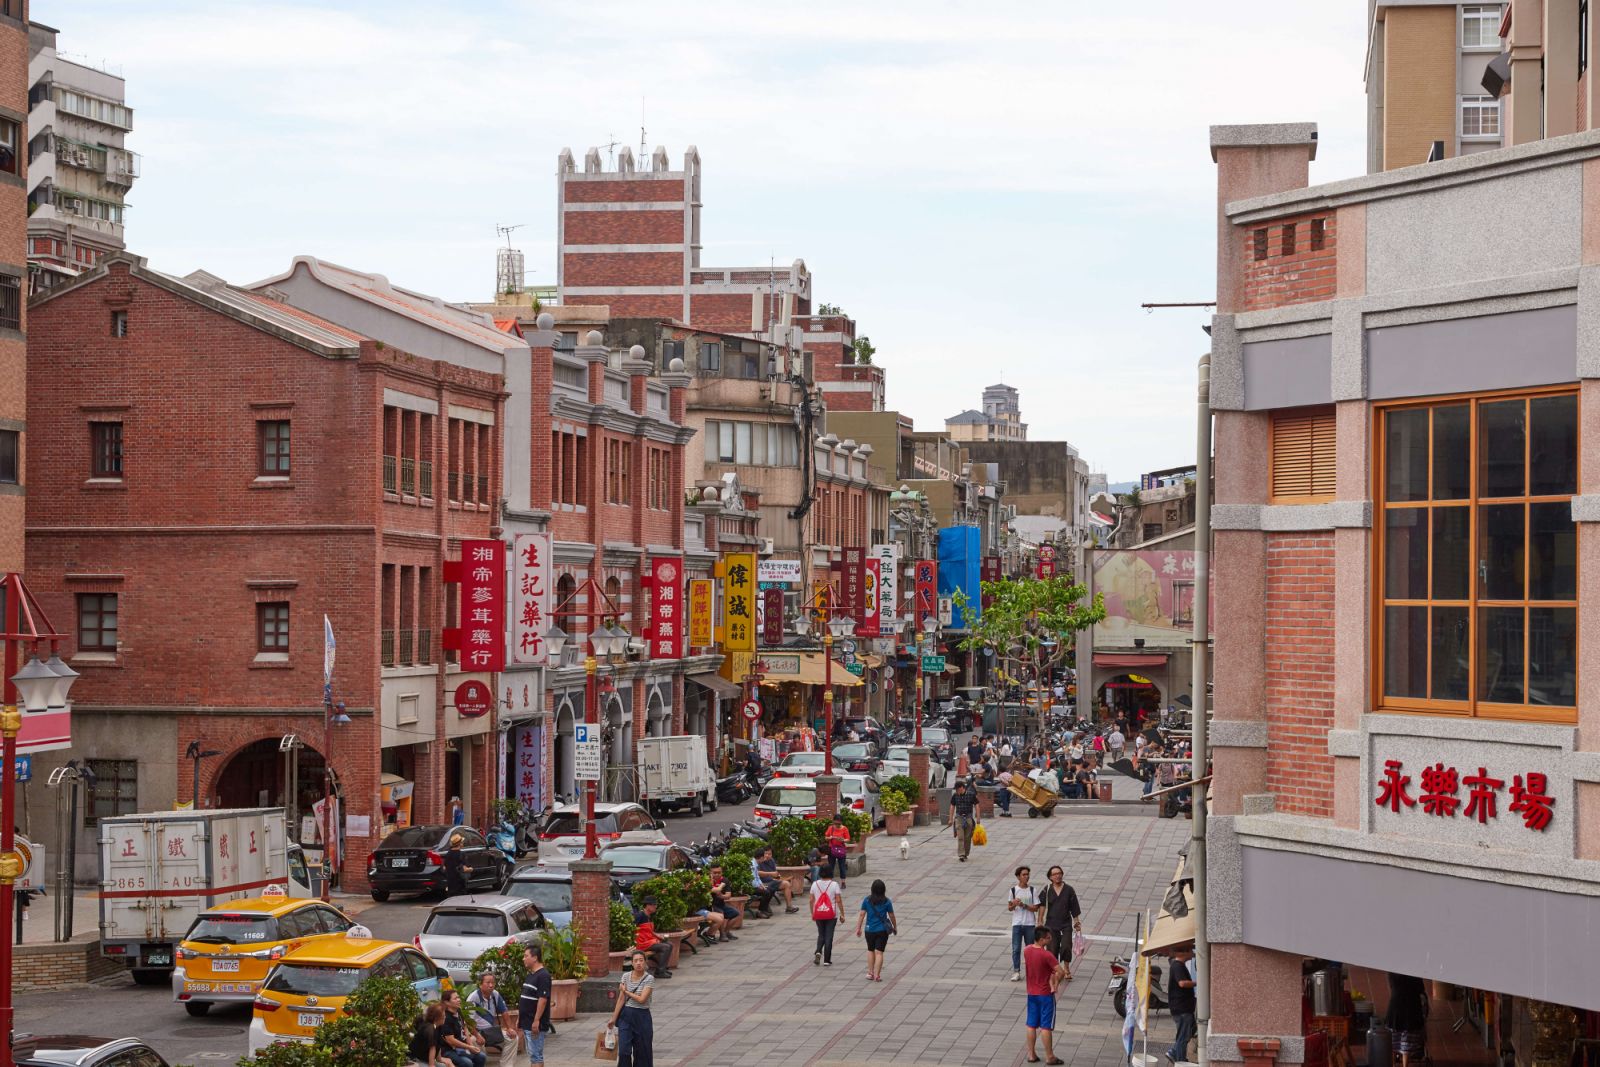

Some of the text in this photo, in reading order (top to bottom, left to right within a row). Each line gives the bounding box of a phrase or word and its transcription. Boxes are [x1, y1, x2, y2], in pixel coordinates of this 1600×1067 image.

[520, 544, 543, 656] 生記藥行
[660, 586, 674, 655] 湘帝燕窩
[728, 564, 749, 619] 偉誠
[520, 731, 536, 811] 生記藥行
[1375, 760, 1556, 831] 永樂市場
[188, 983, 210, 992] 55688
